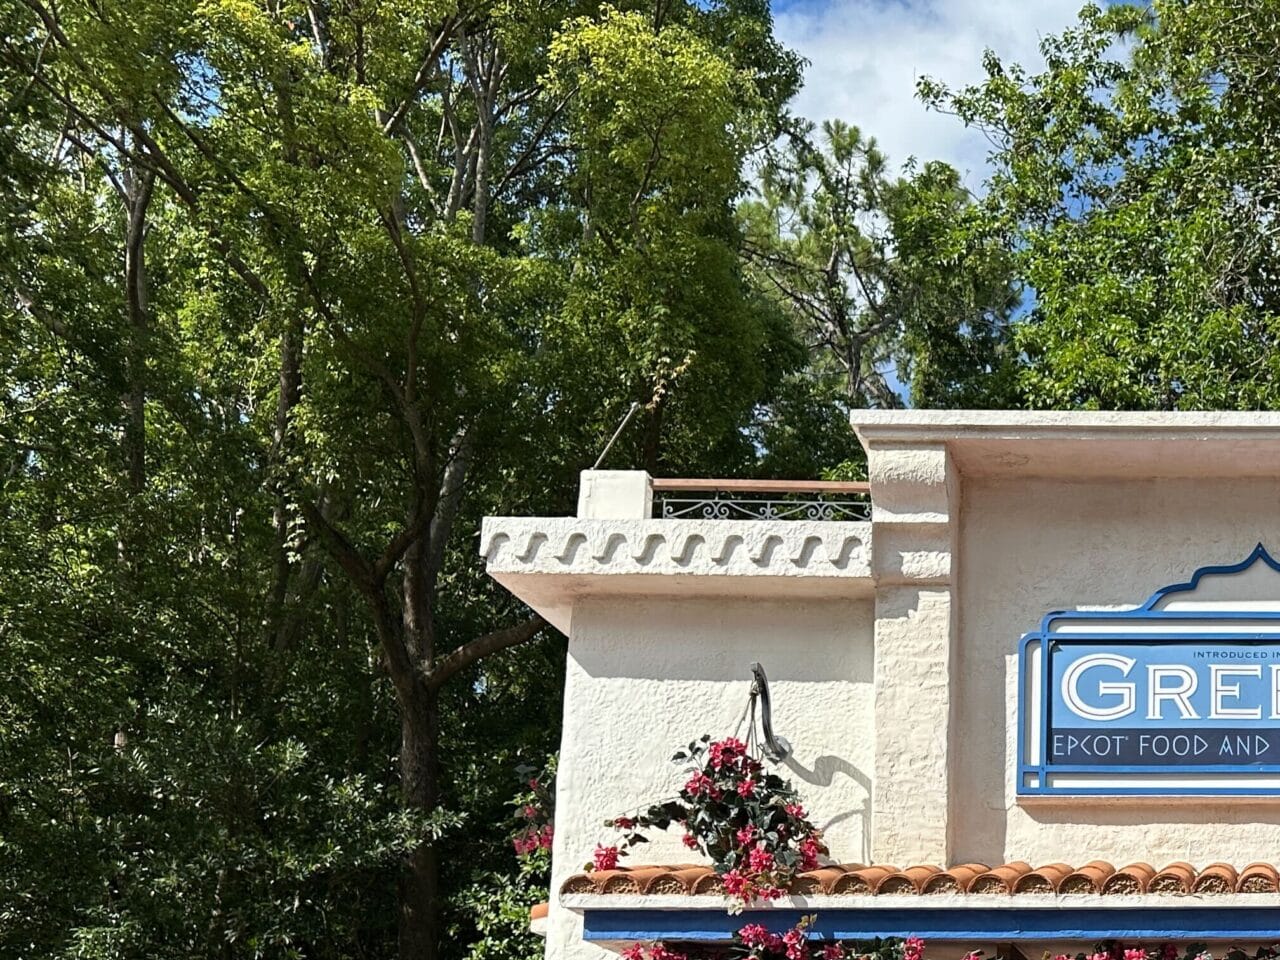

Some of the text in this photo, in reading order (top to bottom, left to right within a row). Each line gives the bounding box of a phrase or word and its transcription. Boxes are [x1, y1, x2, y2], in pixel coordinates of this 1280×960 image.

[1193, 651, 1269, 659] INTRODUCED
[1139, 735, 1209, 756] FOOD
[1219, 735, 1270, 756] AND
